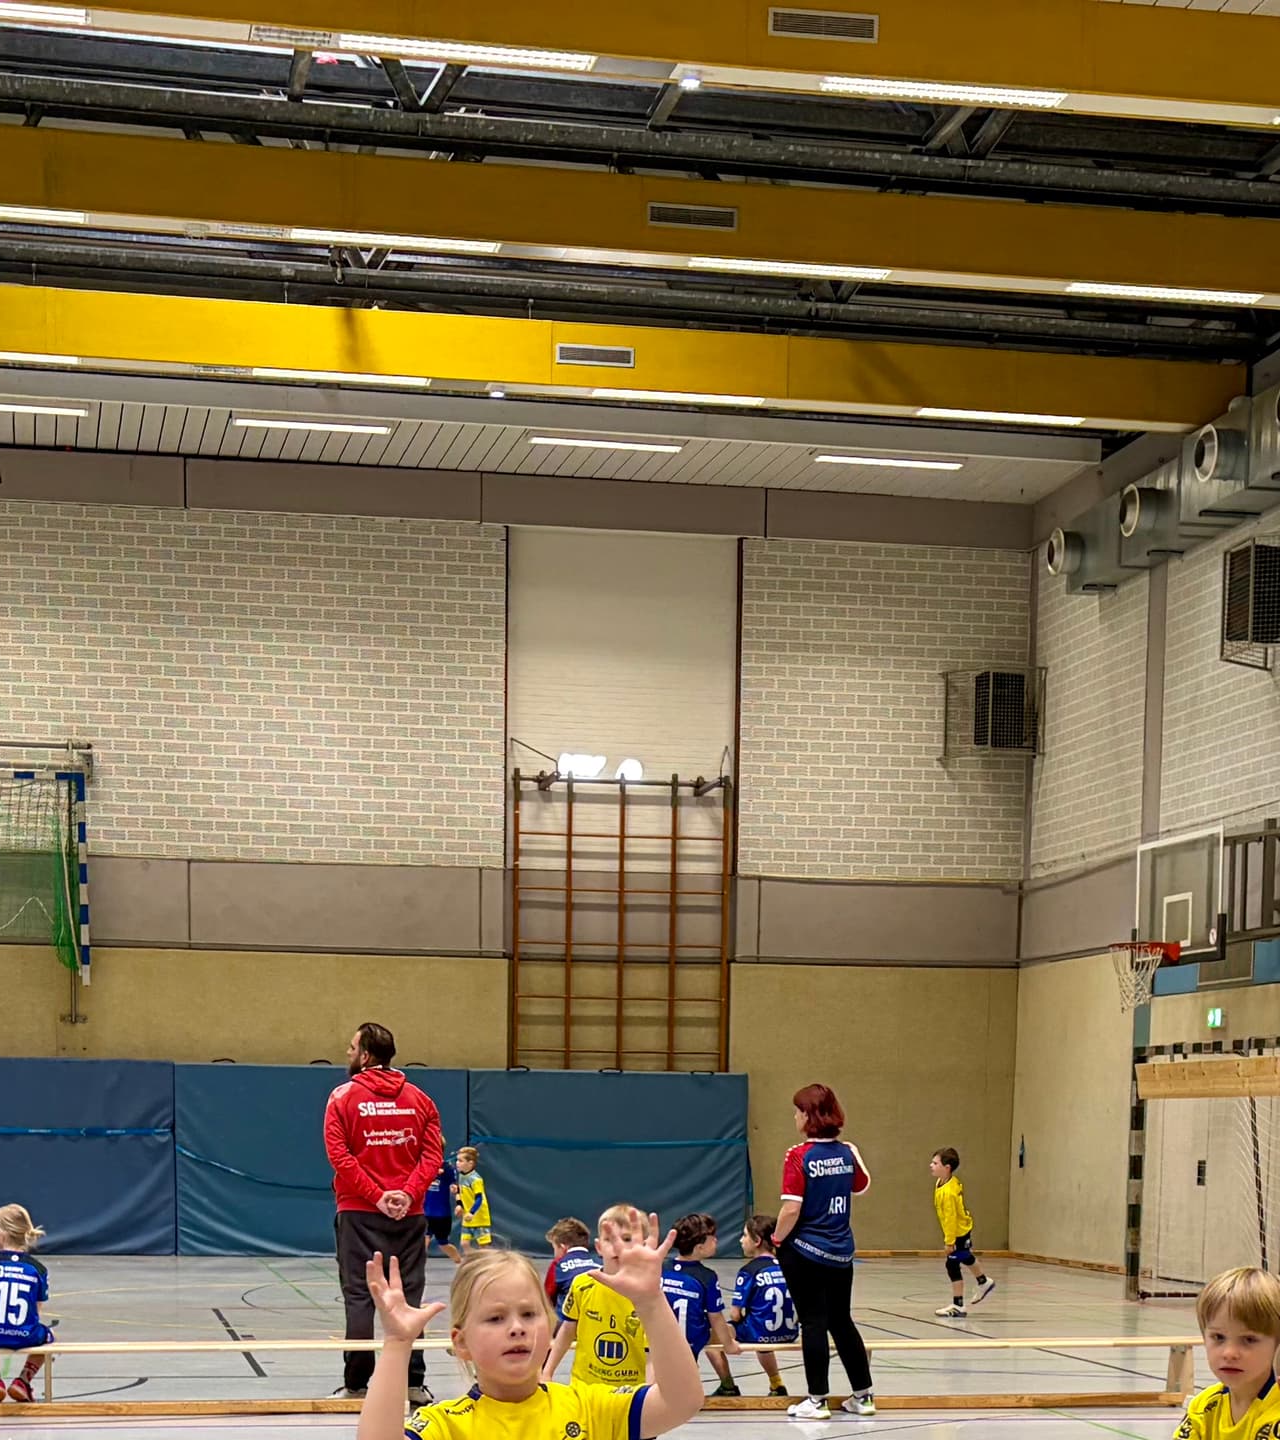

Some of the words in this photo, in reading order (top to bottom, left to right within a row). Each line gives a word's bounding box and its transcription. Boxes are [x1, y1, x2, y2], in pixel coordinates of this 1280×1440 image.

[358, 1101, 376, 1117] SG
[809, 1160, 824, 1178] SG
[756, 1272, 773, 1287] SG
